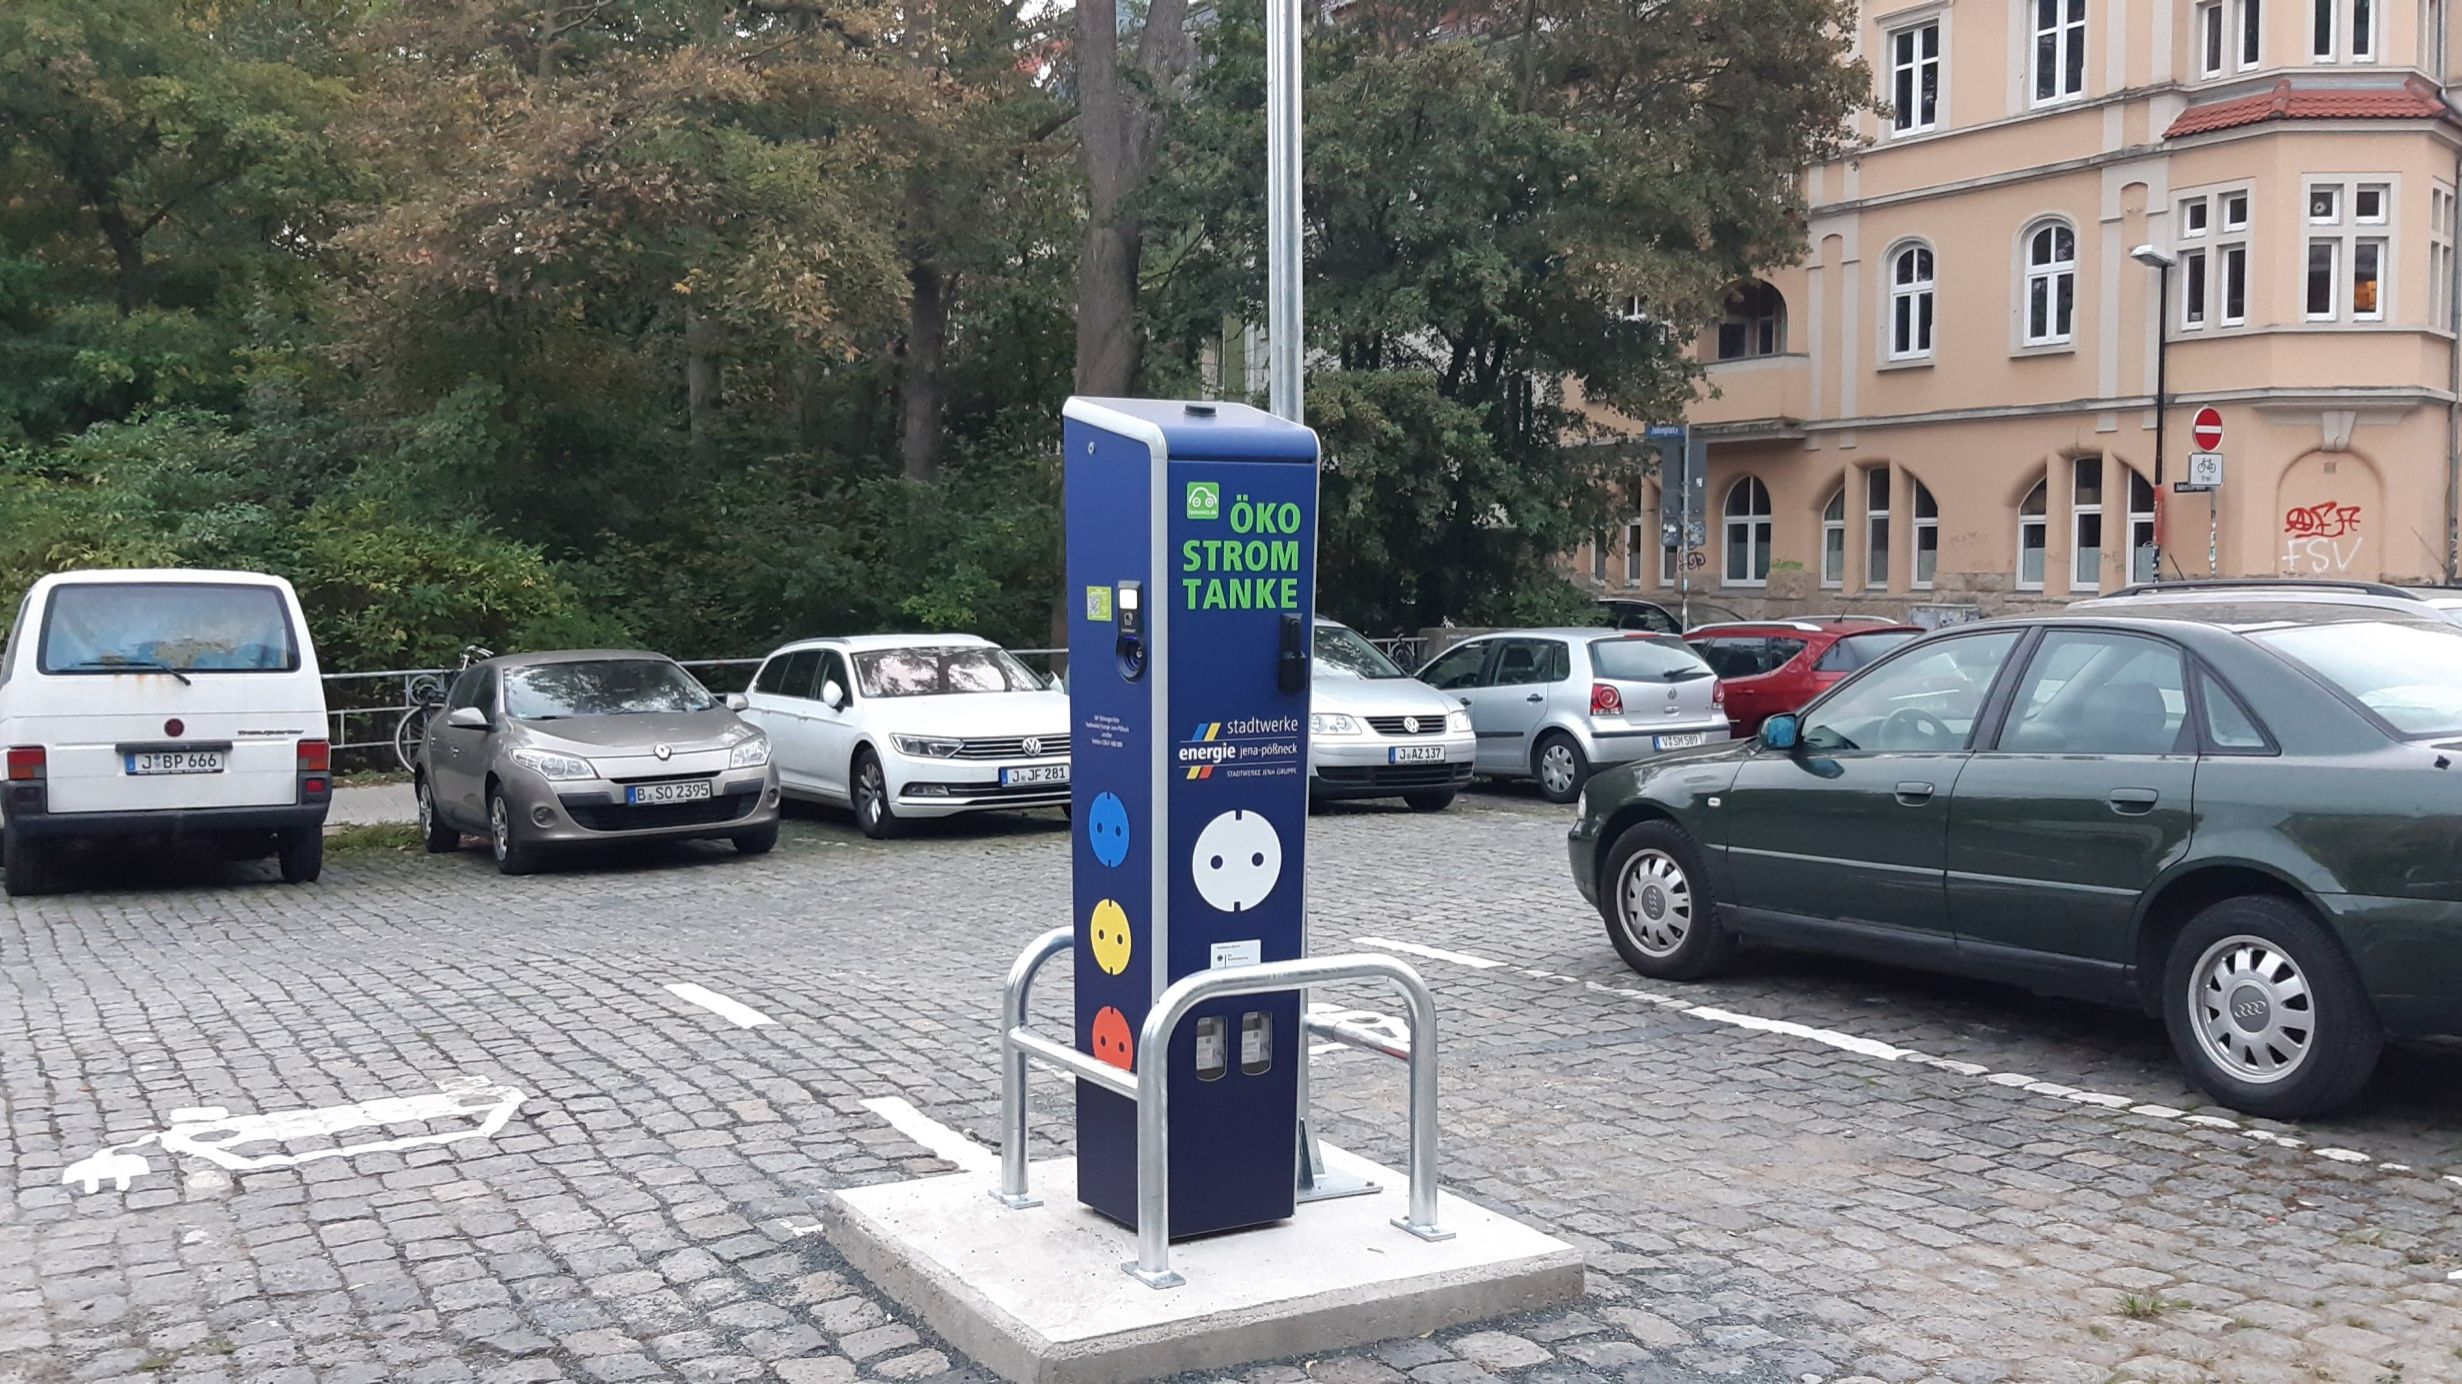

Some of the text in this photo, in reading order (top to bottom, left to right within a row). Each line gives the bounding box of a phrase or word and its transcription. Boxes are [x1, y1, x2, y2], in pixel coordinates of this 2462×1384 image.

[1230, 494, 1301, 534] ÖKO
[1183, 540, 1299, 571] STROM
[2281, 536, 2363, 573] FSV
[1182, 579, 1298, 609] TANKE
[1227, 715, 1299, 735] stadtwerke
[142, 753, 217, 770] J BP 666
[1179, 742, 1298, 764] energie jena-pößneck
[1399, 747, 1441, 760] J AZ 137
[1012, 766, 1066, 783] J JF 281
[1226, 770, 1261, 778] STADTWERKE
[1276, 767, 1297, 775] GRUPPE
[637, 788, 647, 802] B
[676, 783, 709, 799] 2395
